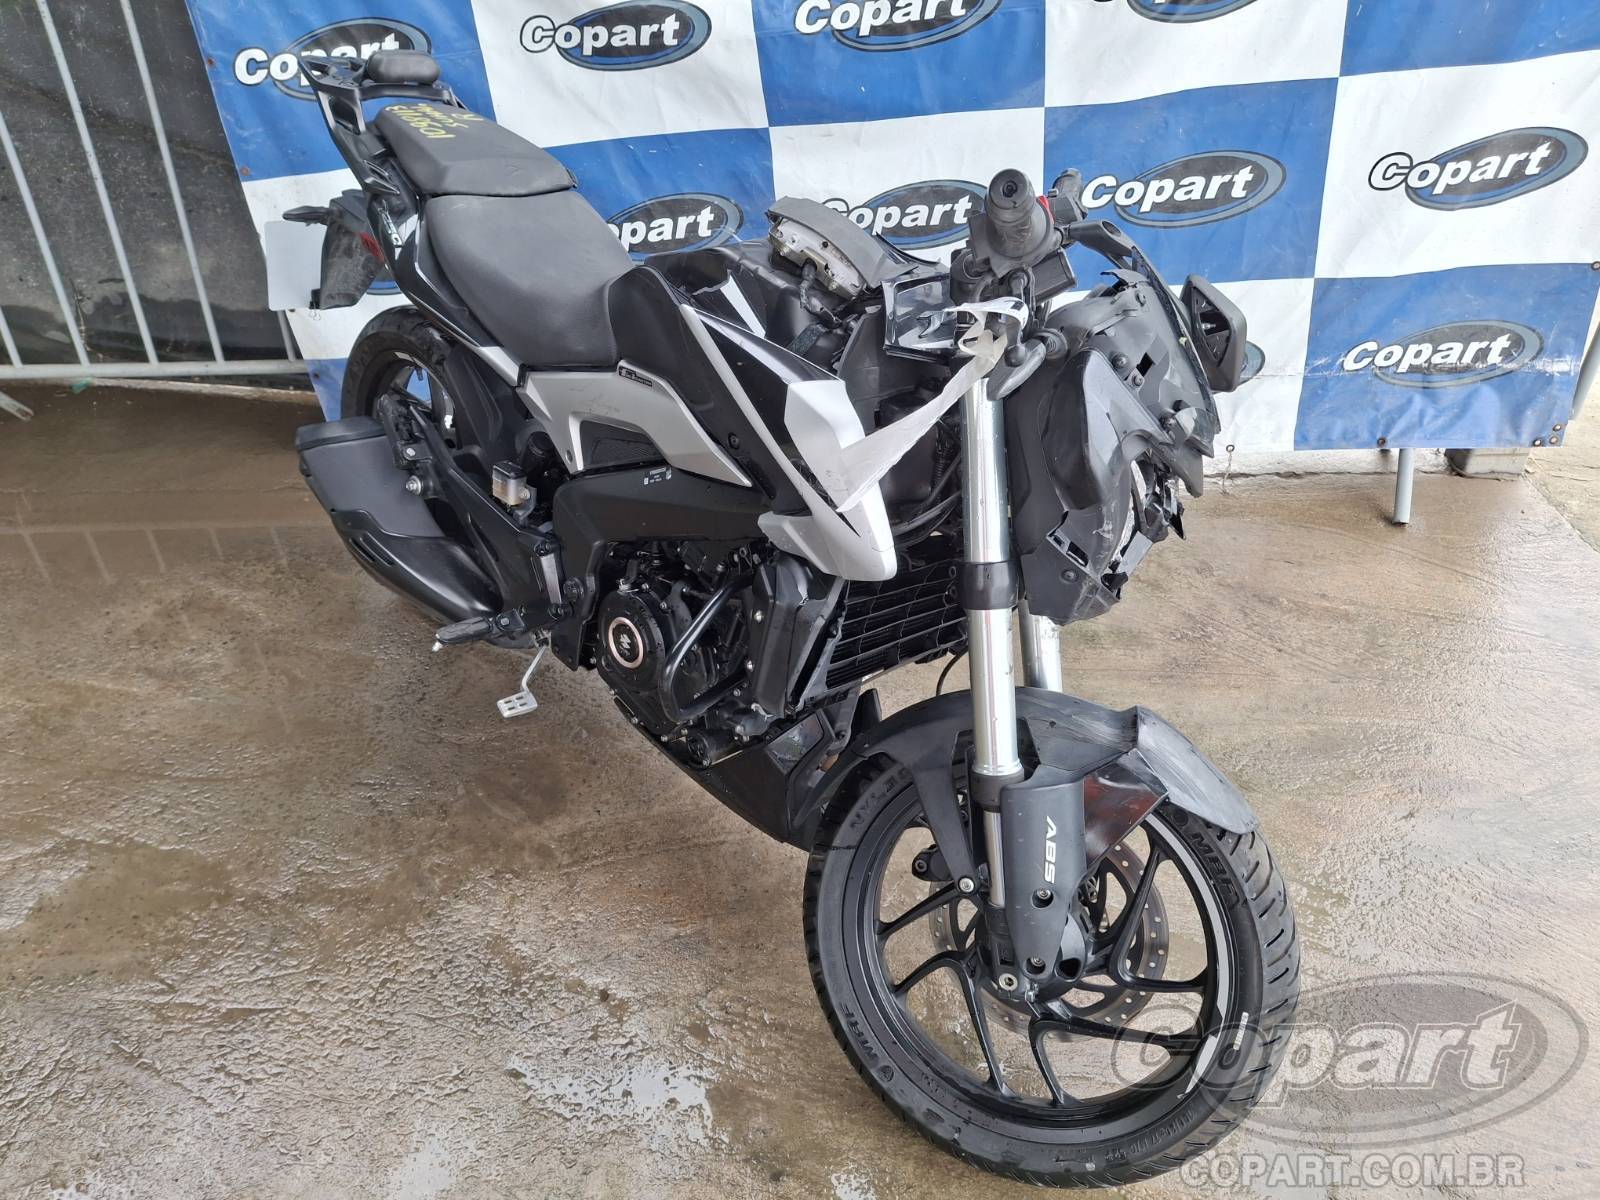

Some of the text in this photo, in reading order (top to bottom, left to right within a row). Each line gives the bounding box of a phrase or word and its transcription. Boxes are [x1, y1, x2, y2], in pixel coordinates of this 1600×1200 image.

[520, 13, 682, 55] Copart
[1081, 166, 1254, 213] Copart
[1368, 141, 1552, 195] Copart
[607, 206, 715, 252] part
[1342, 333, 1512, 373] Copart
[1044, 815, 1057, 884] ABS
